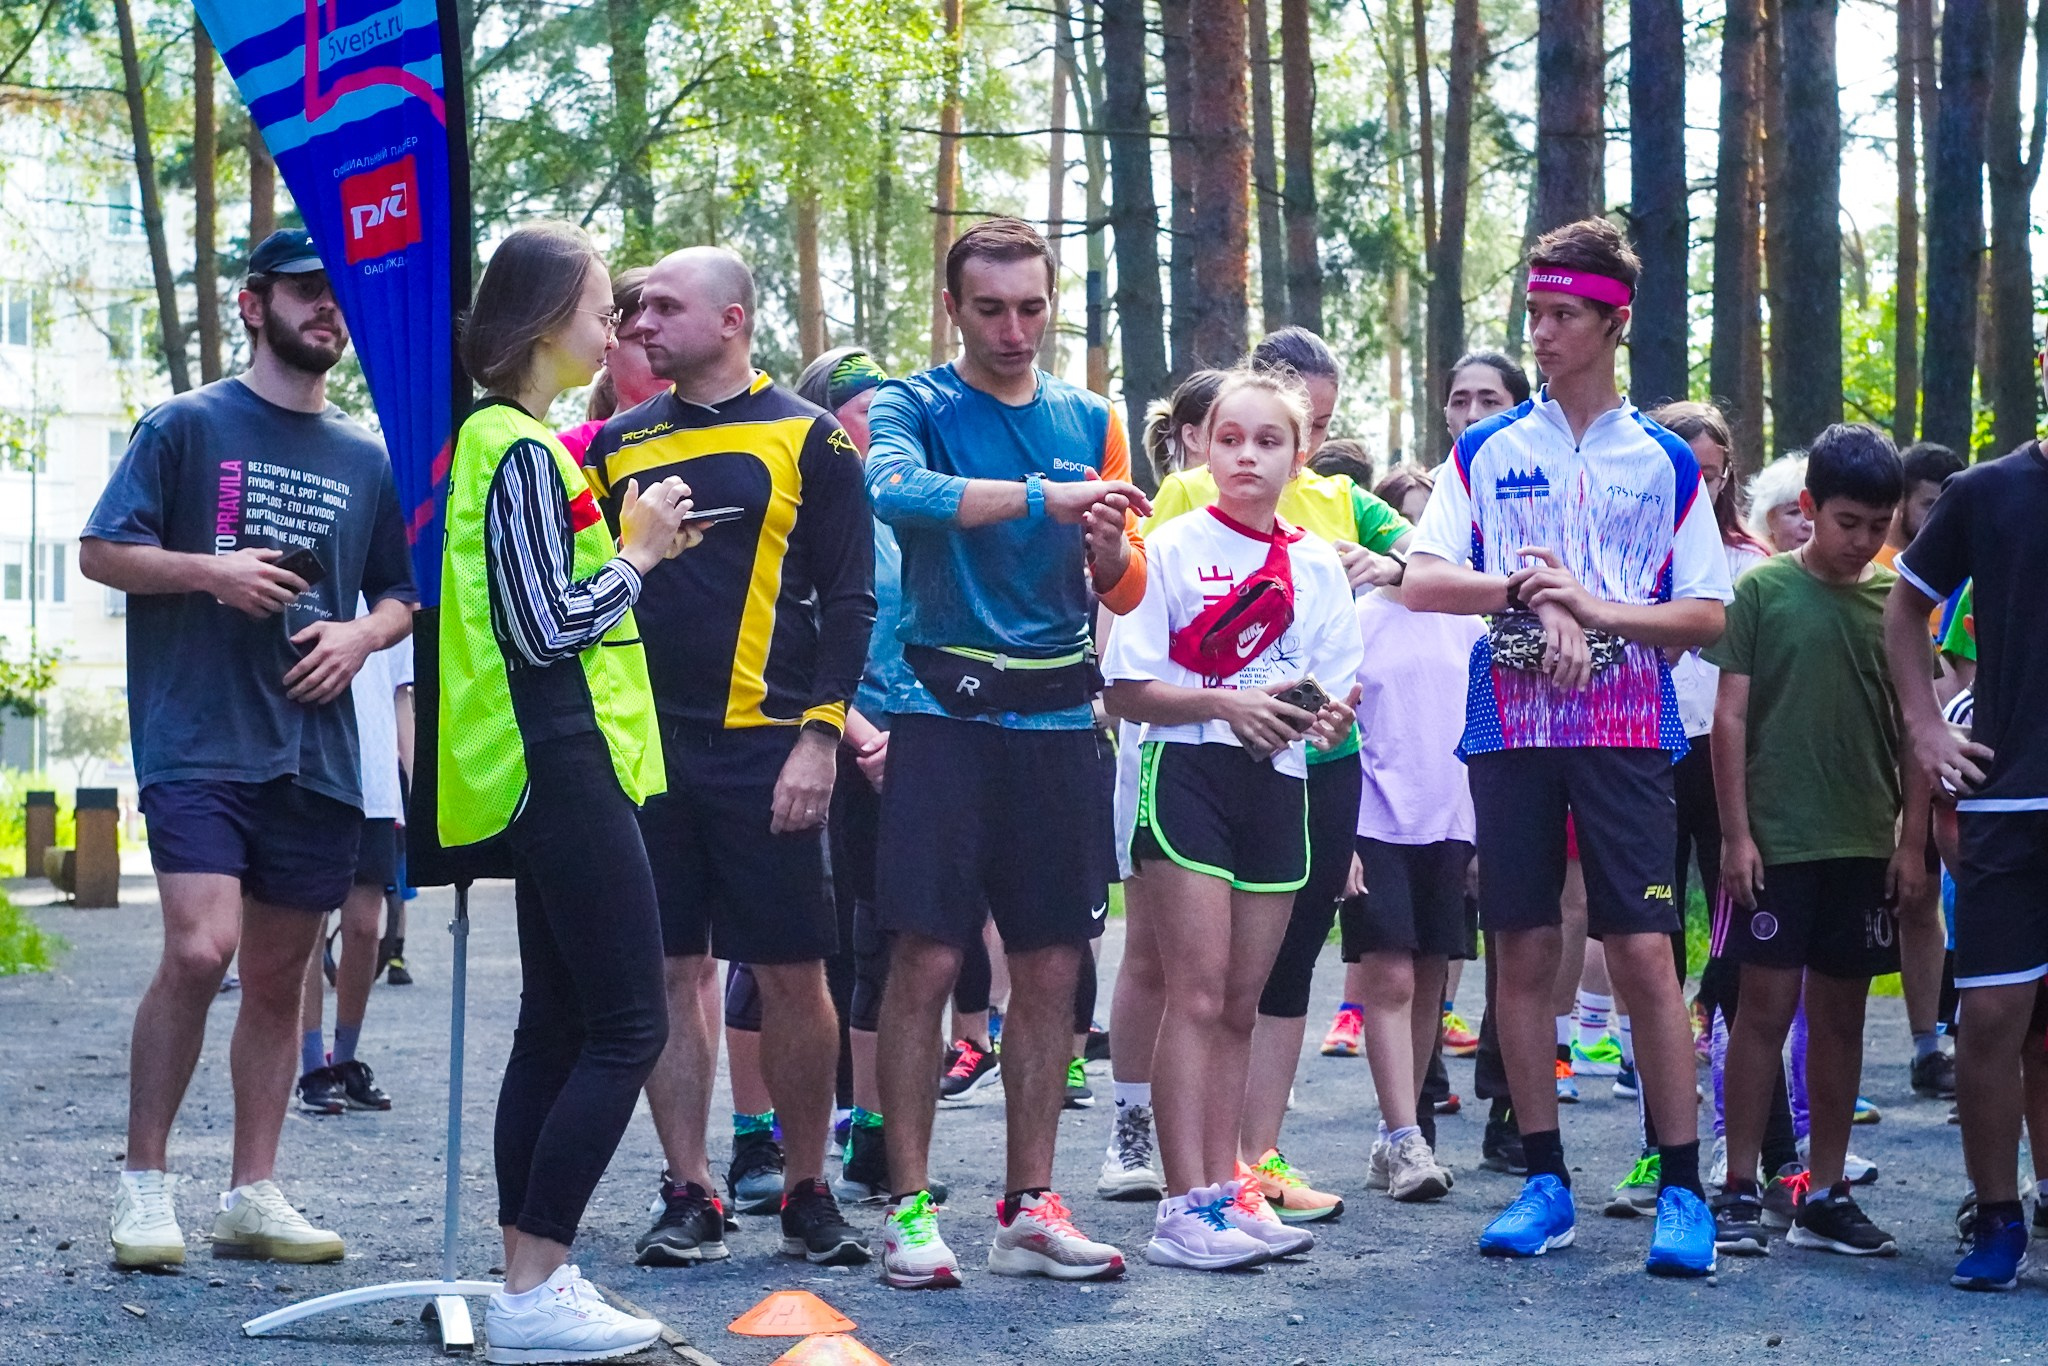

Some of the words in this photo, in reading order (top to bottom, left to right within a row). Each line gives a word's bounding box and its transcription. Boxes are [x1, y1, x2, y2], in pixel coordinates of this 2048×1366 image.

[328, 12, 403, 61] 5verst.ru
[621, 421, 674, 442] ROYAL
[248, 461, 262, 473] BEZ
[263, 463, 290, 479] STOPOV
[290, 469, 301, 481] NA
[302, 471, 321, 486] VSYU
[247, 476, 275, 489] FIYUCHI
[298, 486, 318, 500] SPOT
[247, 491, 283, 509] STOP-LOSS
[287, 500, 302, 513] ETO
[244, 524, 261, 536] NIJE
[278, 530, 289, 543] NE
[295, 519, 307, 531] NE
[956, 675, 981, 697] R
[1643, 885, 1672, 900] FILA
